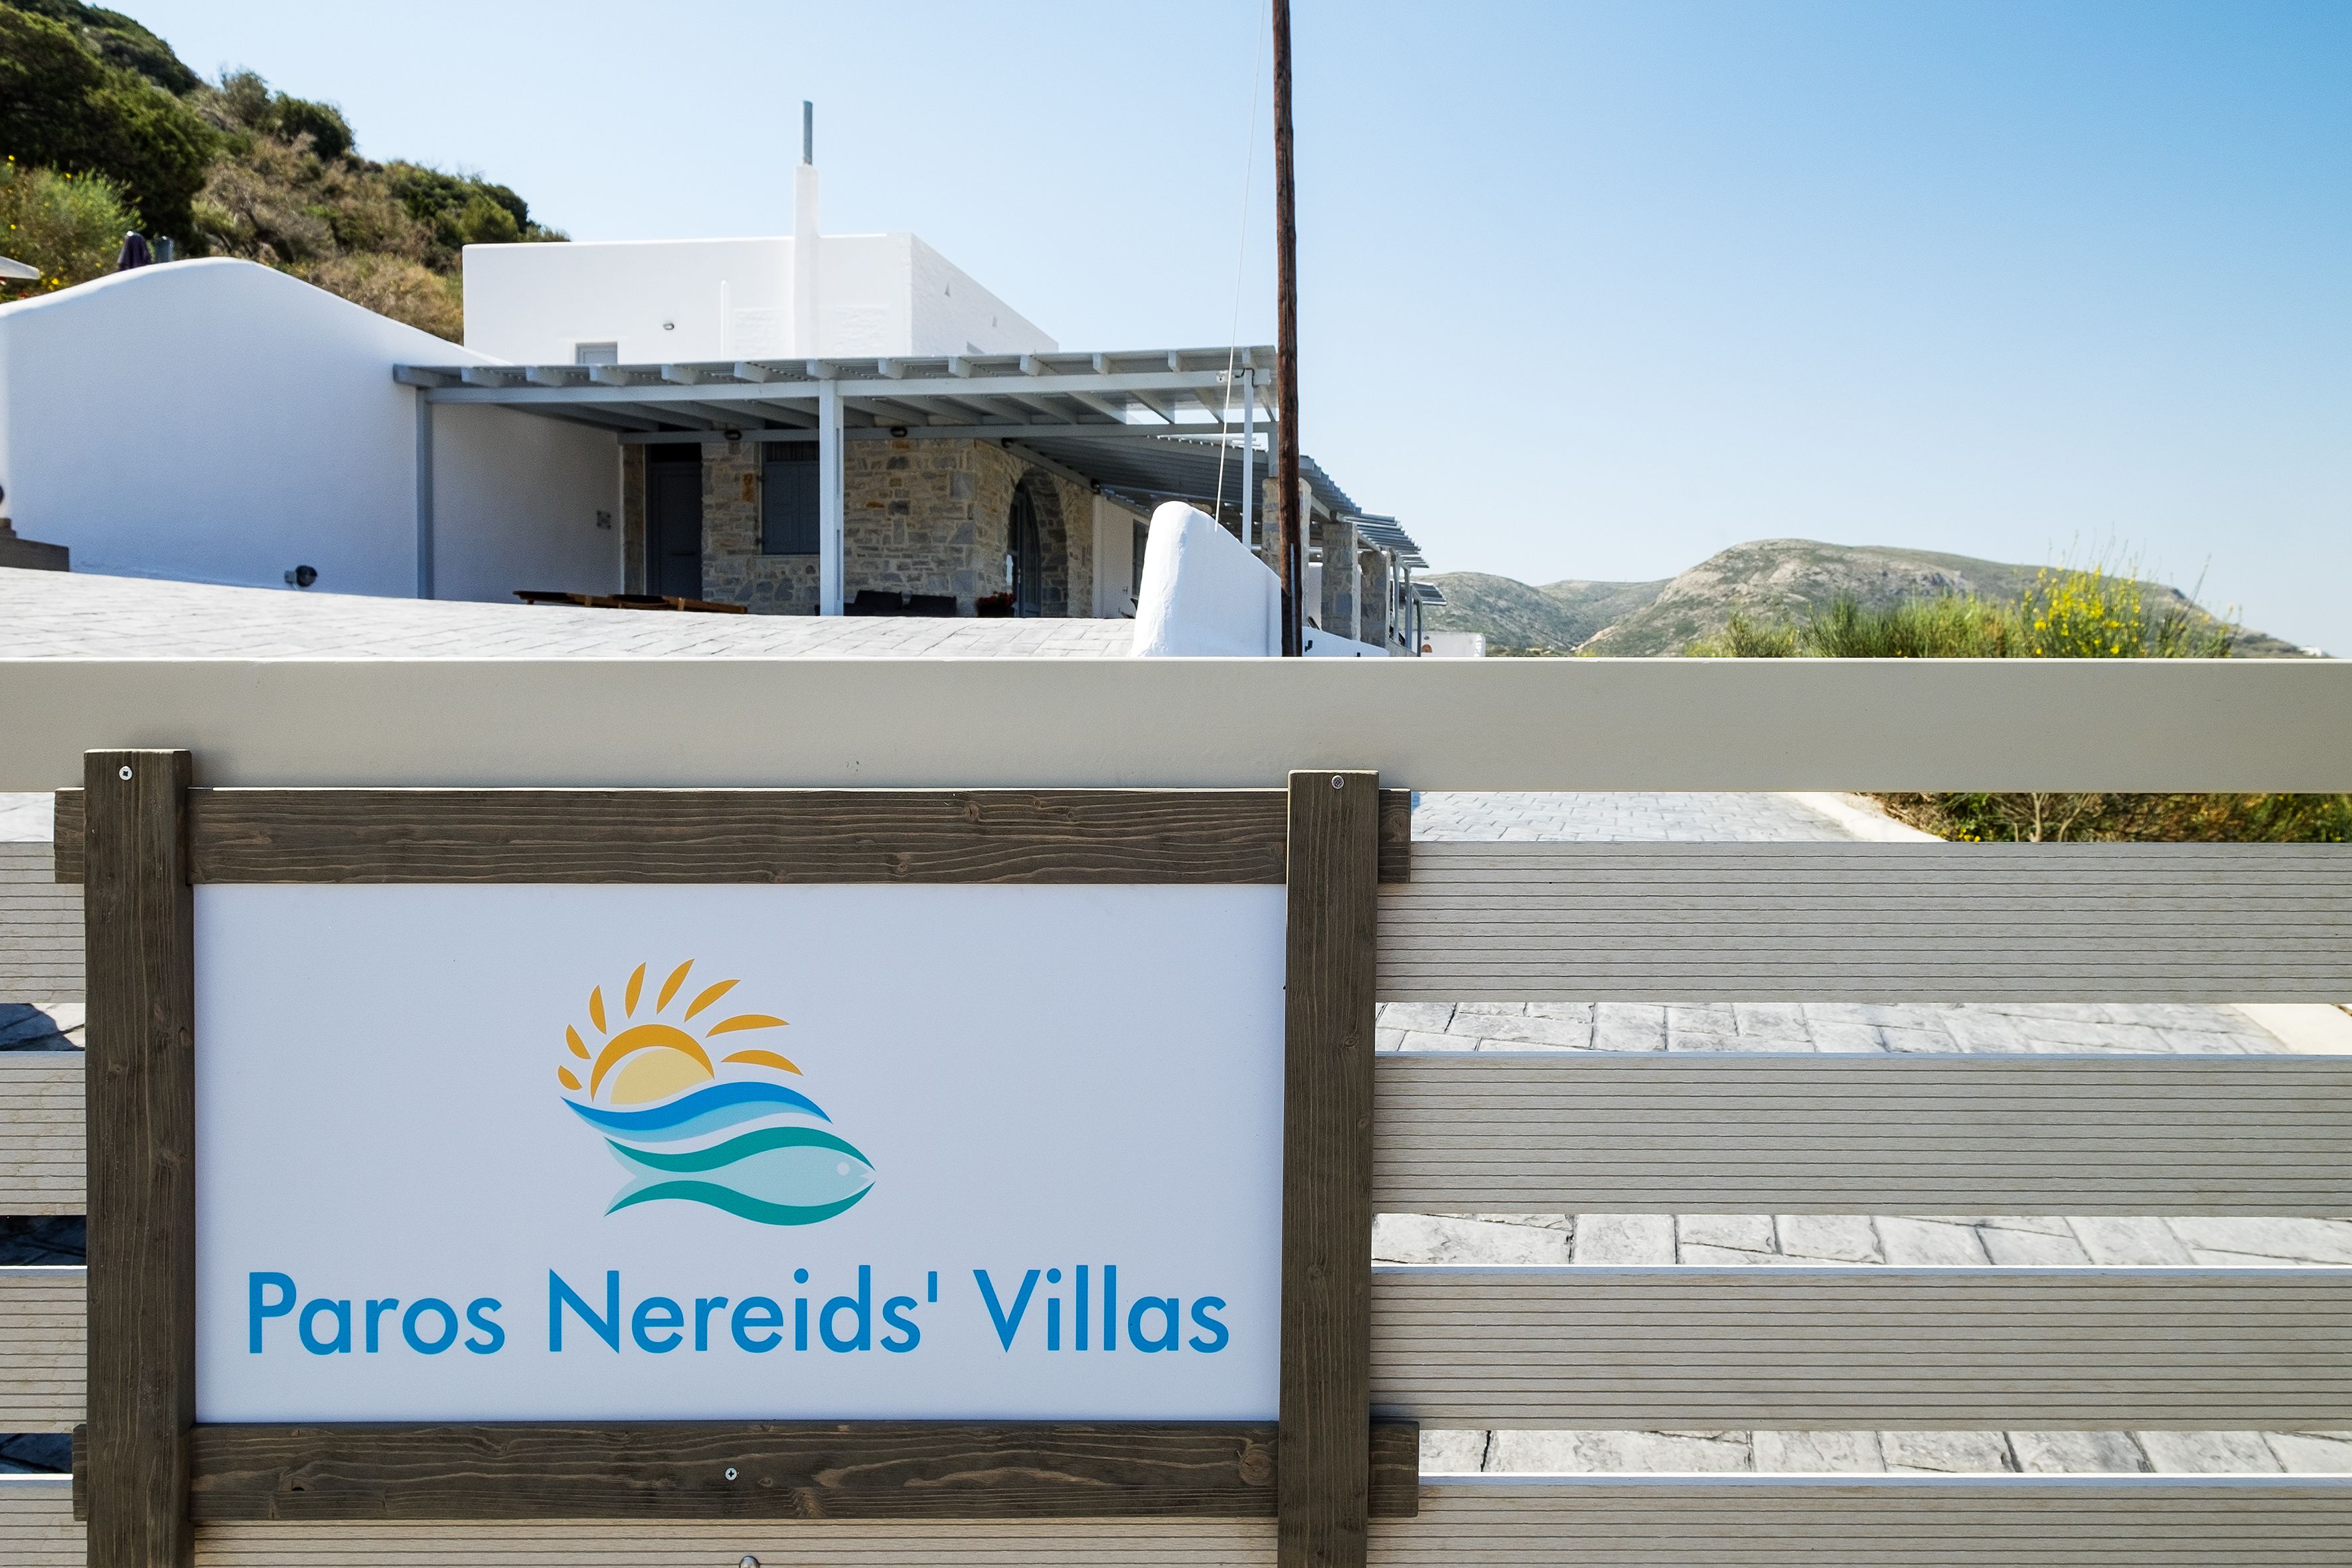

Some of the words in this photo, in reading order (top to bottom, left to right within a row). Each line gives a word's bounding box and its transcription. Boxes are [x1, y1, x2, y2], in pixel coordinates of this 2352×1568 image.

[248, 1271, 507, 1356] Paros
[548, 1263, 939, 1355] Nereids'
[972, 1263, 1230, 1354] Villas
